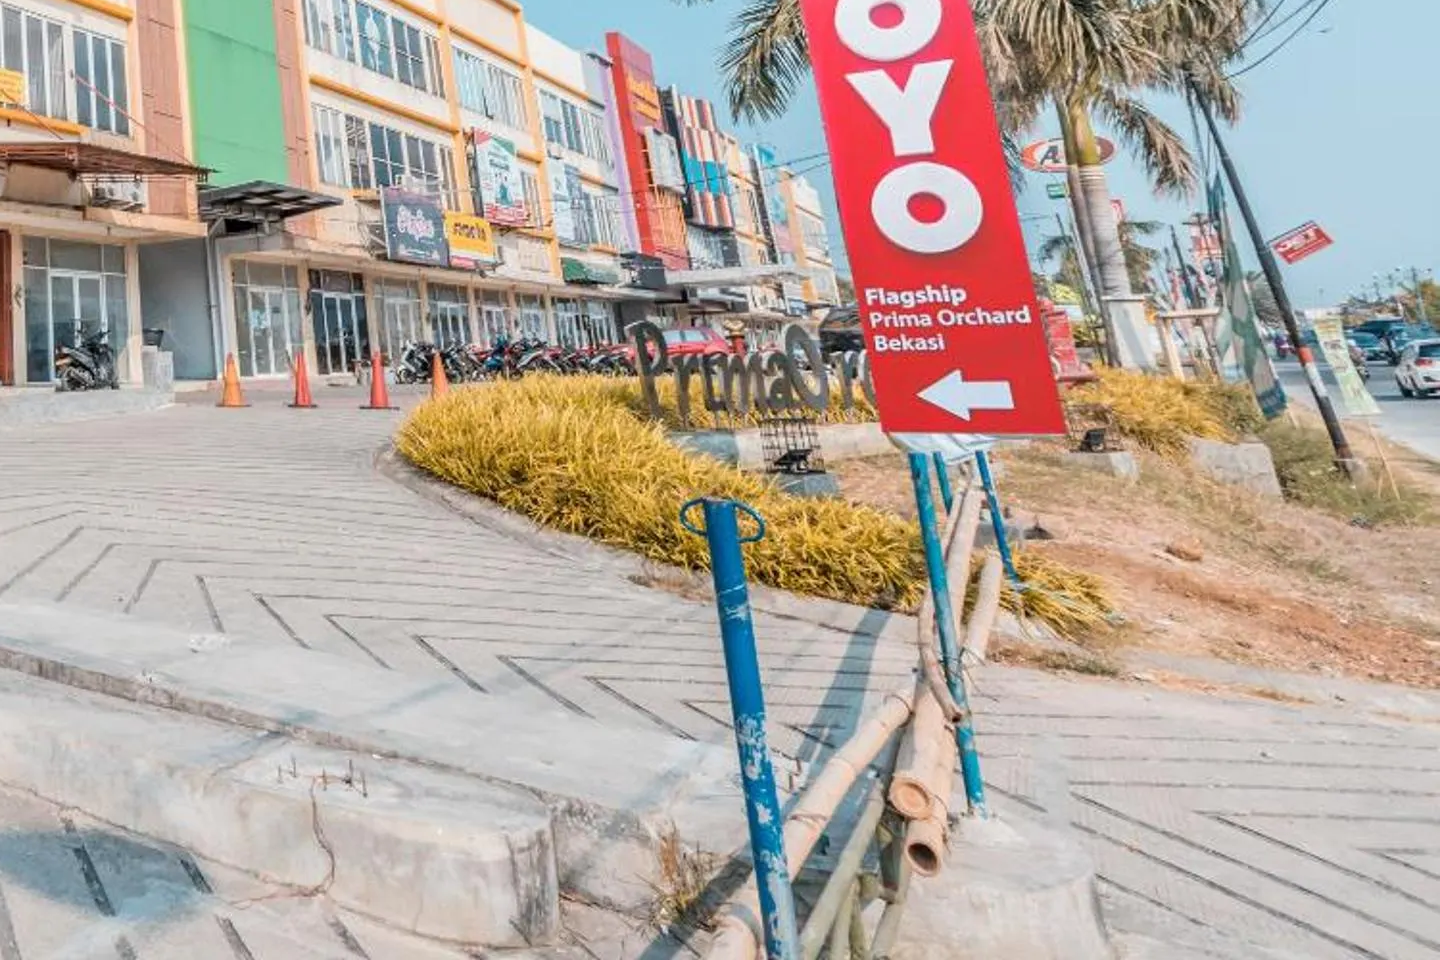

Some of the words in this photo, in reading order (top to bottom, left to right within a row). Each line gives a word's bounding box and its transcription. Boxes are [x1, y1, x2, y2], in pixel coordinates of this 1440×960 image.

[864, 284, 967, 308] Flagship
[869, 311, 932, 328] Prima
[937, 305, 1031, 327] Orchard
[873, 333, 945, 352] Bekasi
